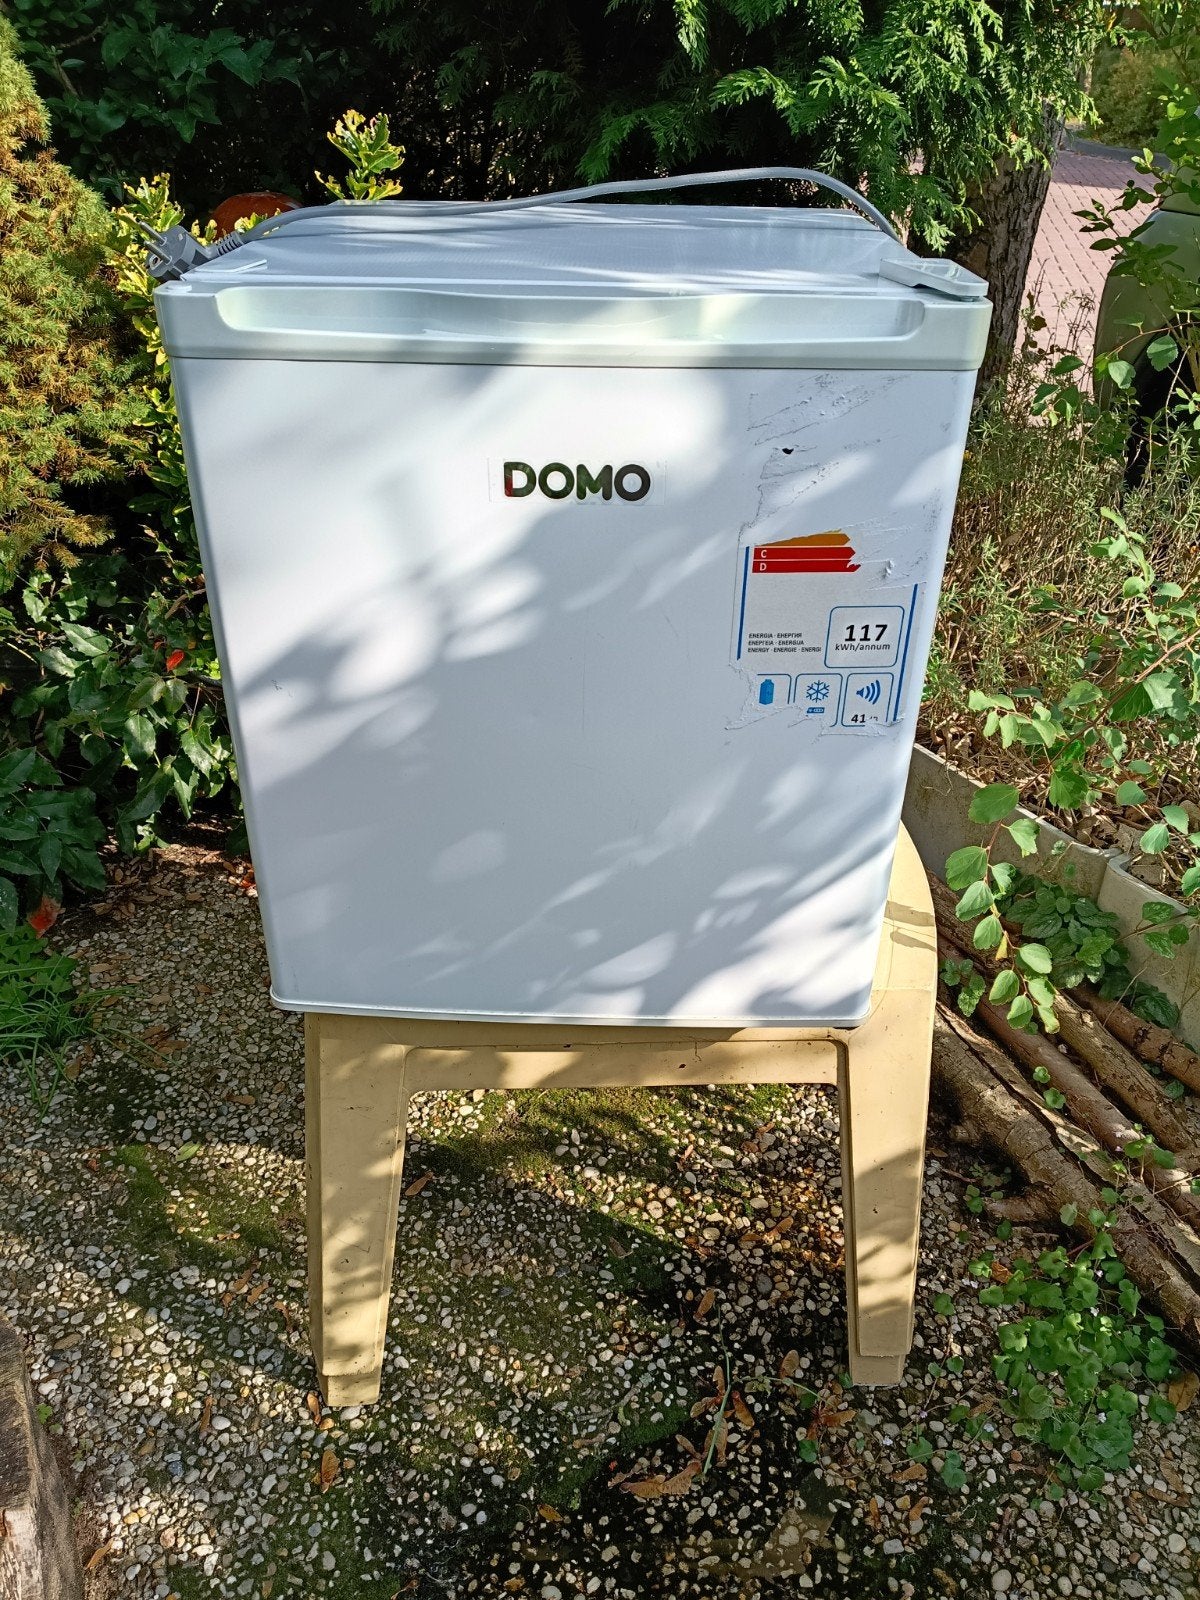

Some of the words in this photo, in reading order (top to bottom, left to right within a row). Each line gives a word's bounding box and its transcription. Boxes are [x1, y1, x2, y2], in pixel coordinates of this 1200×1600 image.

[503, 461, 651, 501] DOMO
[760, 549, 767, 559] C
[759, 562, 767, 571] D
[844, 624, 888, 642] 117
[834, 643, 891, 652] kWh/annum
[850, 713, 866, 724] 41
